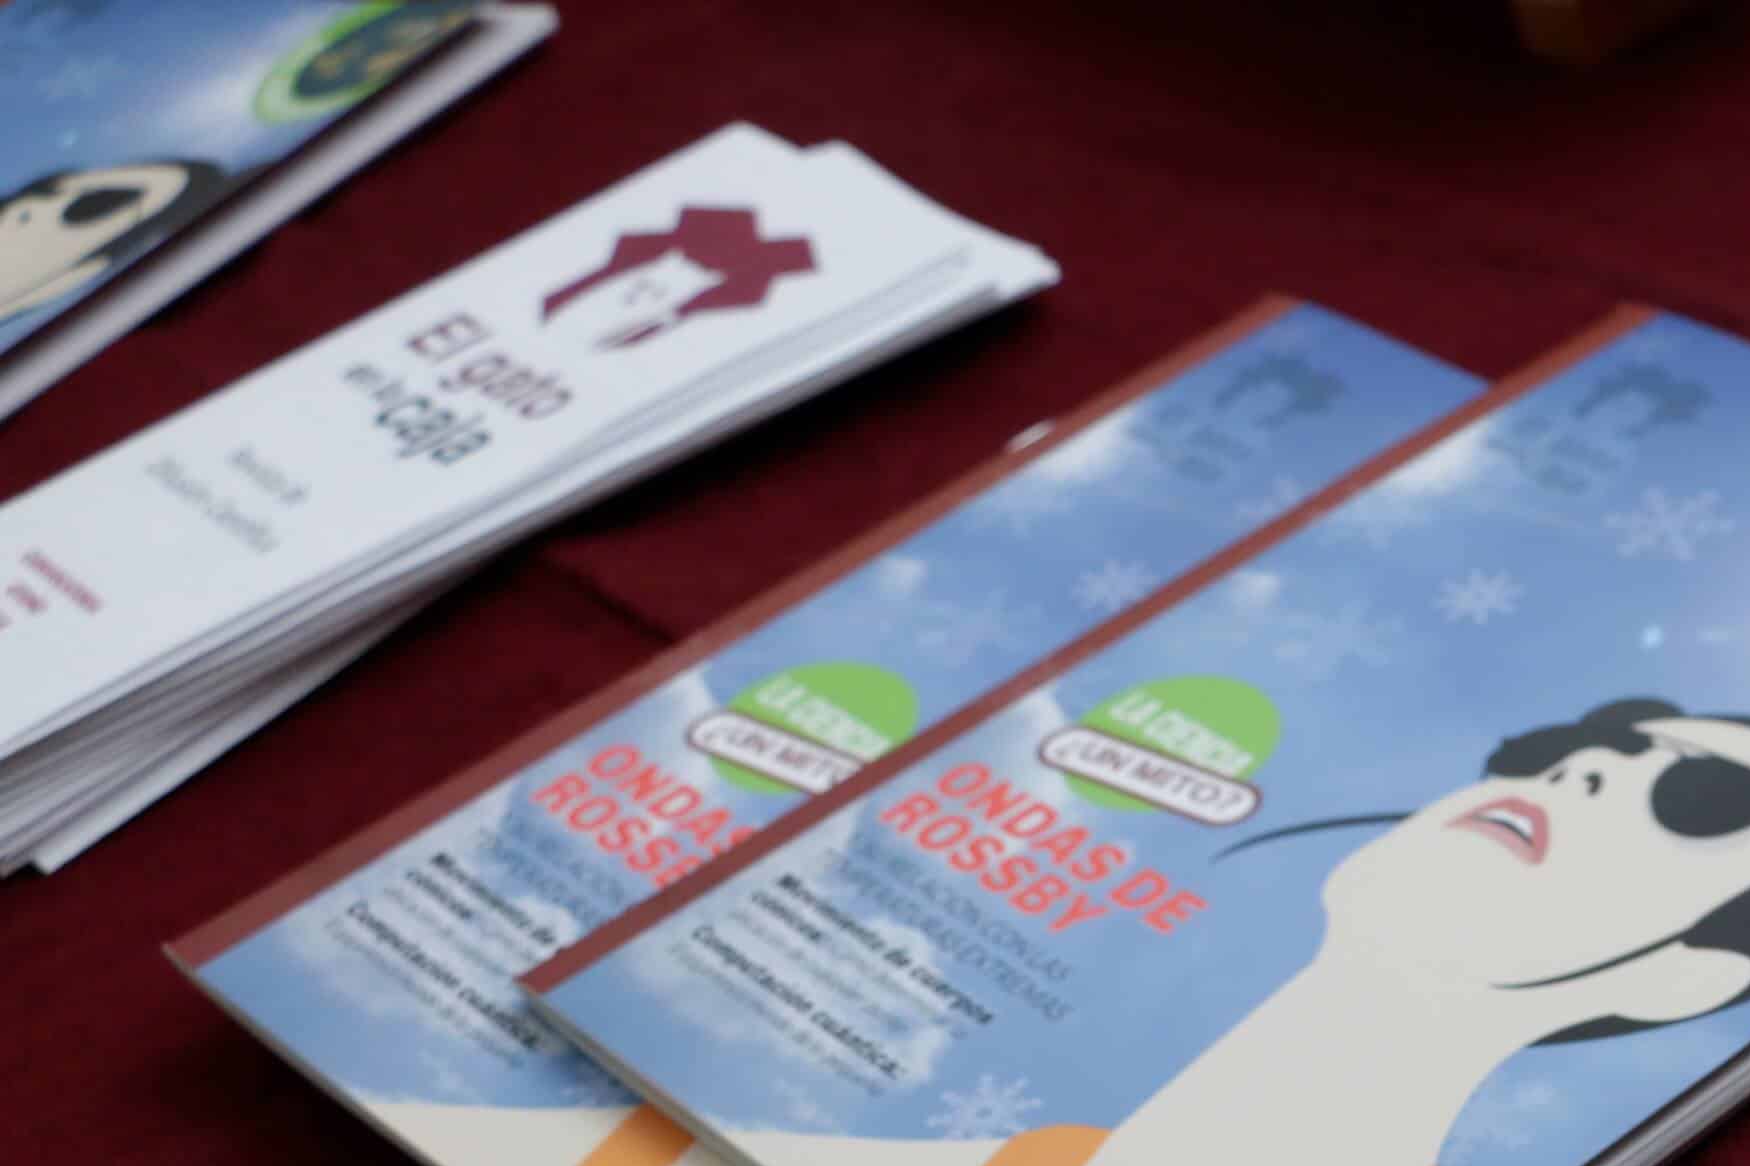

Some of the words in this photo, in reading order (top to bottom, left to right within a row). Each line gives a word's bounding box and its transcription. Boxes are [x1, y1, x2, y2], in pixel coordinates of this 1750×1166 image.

[878, 793, 1111, 934] ROSSBY
[935, 762, 1127, 884] ONDAS
[1107, 867, 1209, 934] DE
